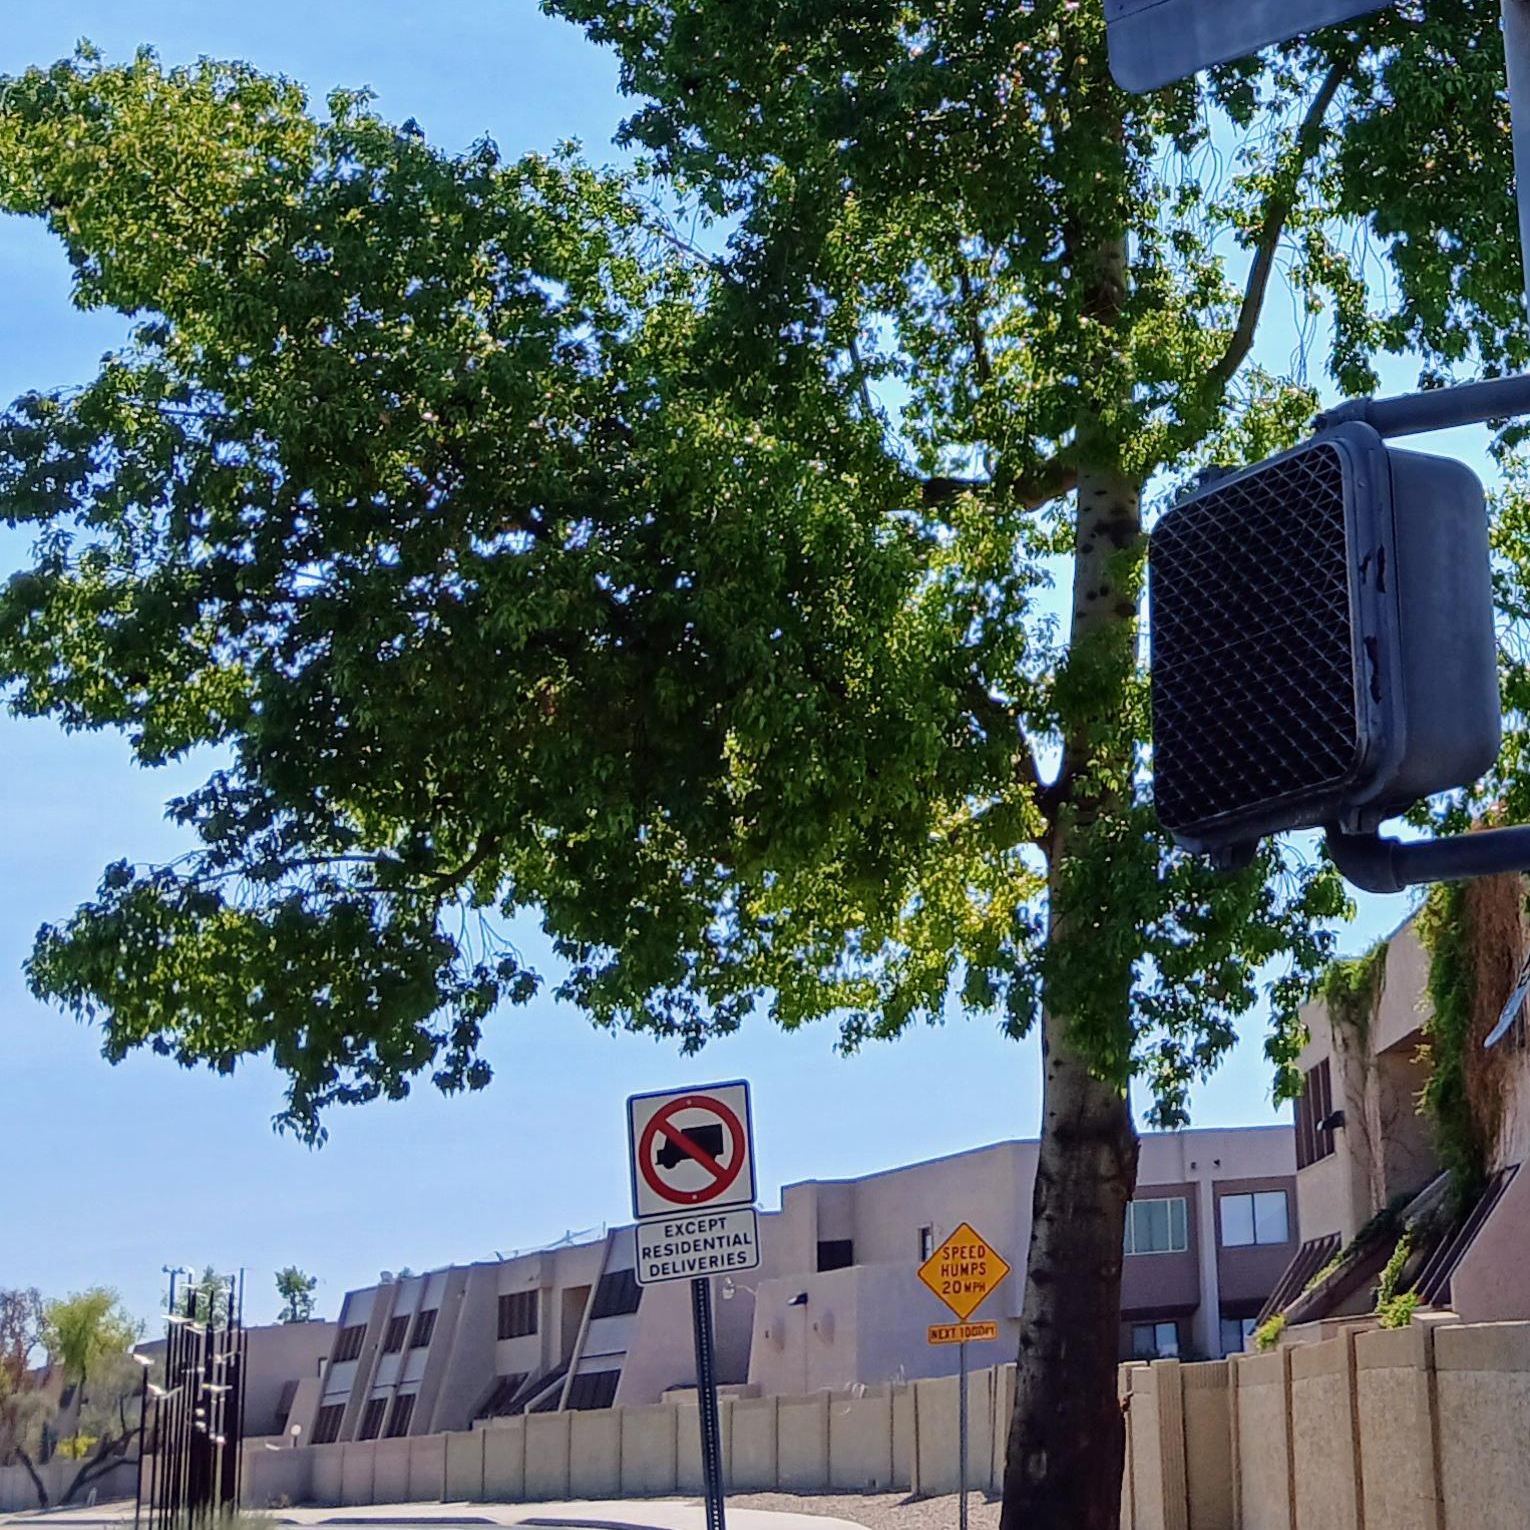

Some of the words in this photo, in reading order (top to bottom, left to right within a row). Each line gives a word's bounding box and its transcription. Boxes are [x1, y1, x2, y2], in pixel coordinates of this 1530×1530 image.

[664, 1217, 727, 1238] EXCEPT
[642, 1232, 752, 1260] RESIDENTIAL
[943, 1245, 986, 1260] SPEED
[650, 1251, 747, 1277] DELIVERIES
[941, 1262, 986, 1277] HUMPS
[931, 1327, 955, 1339] NEXT
